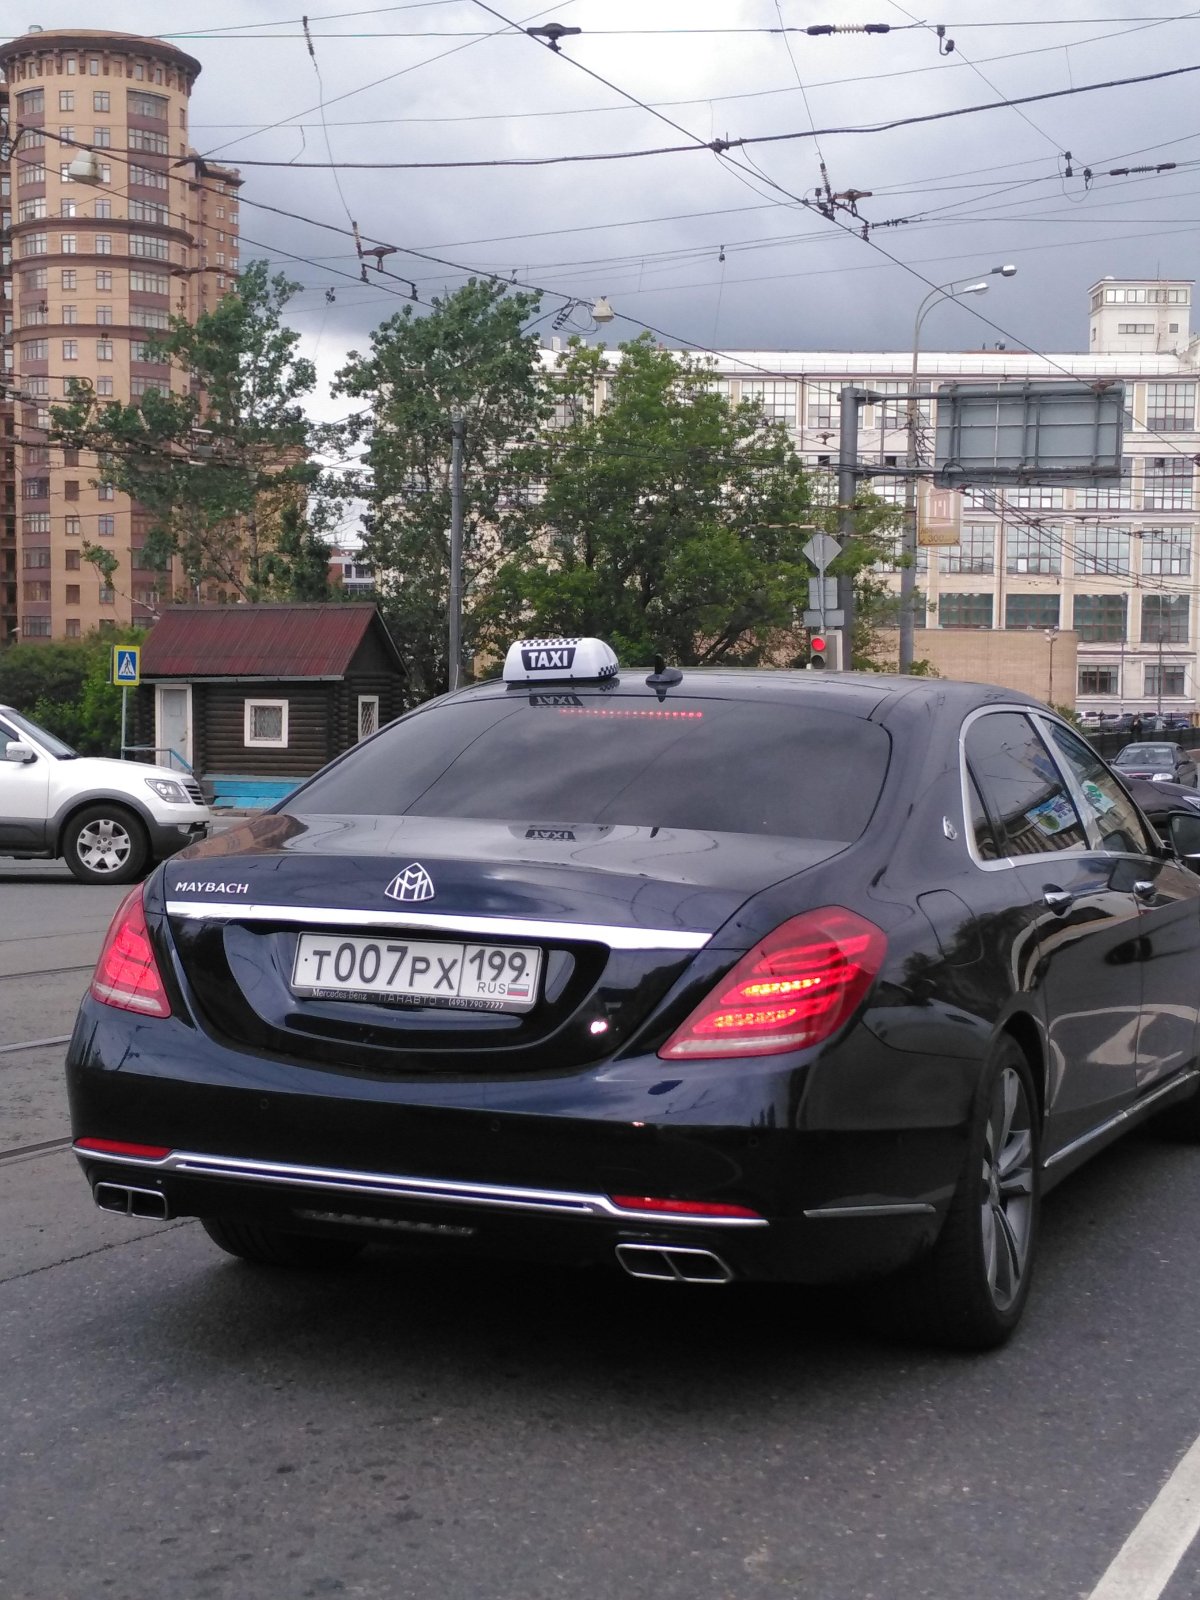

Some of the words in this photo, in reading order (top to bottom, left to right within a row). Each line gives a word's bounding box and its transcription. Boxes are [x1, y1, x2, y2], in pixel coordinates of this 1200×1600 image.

[528, 650, 569, 668] TAXI
[175, 882, 249, 894] MAYBACH
[469, 949, 527, 983] 199
[477, 982, 506, 994] RUS
[311, 988, 368, 1001] Mercedes-Benz
[448, 999, 468, 1008] (495)
[469, 1000, 504, 1010] 790-7777
